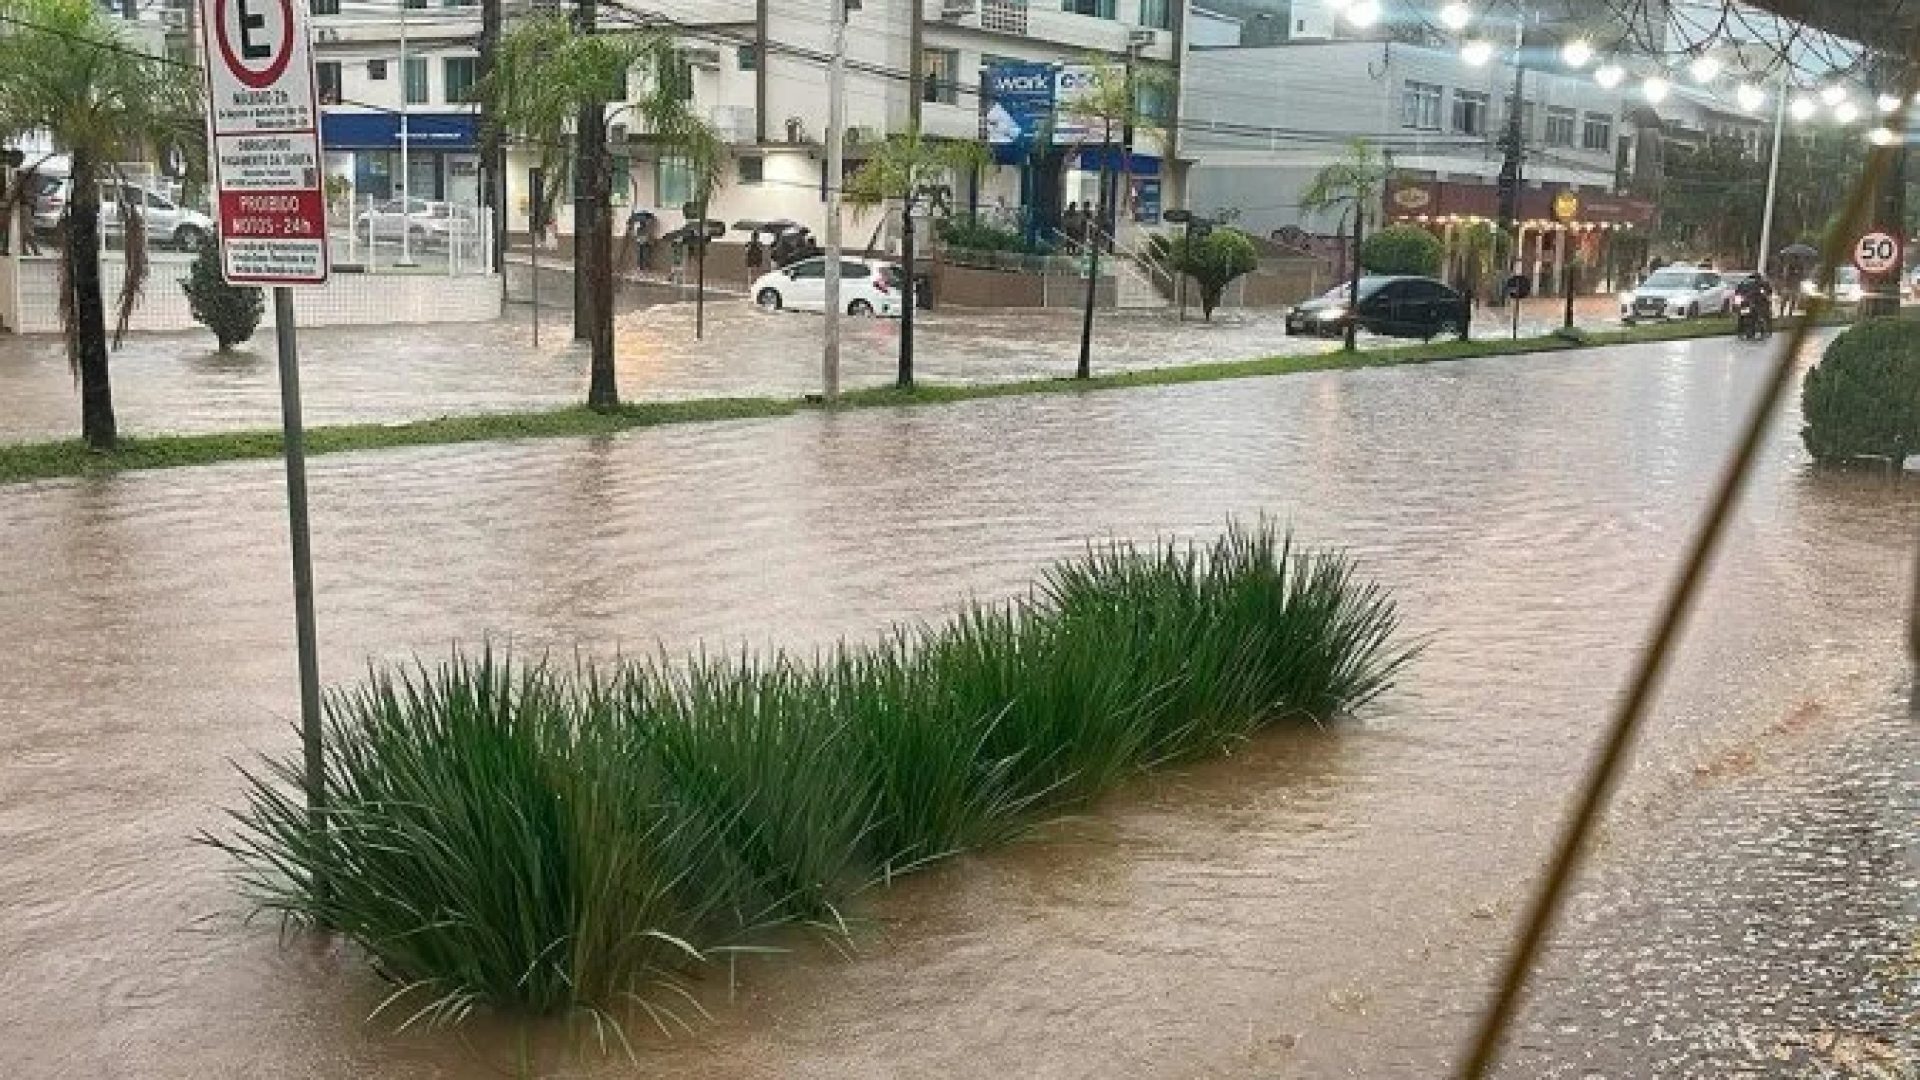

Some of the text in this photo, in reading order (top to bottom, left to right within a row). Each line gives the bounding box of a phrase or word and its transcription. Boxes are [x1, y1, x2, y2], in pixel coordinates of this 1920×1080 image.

[239, 0, 271, 59] E
[239, 195, 300, 212] PROIBIDO
[233, 217, 274, 234] MOTOS
[284, 217, 311, 234] 24h
[1861, 238, 1893, 260] 50
